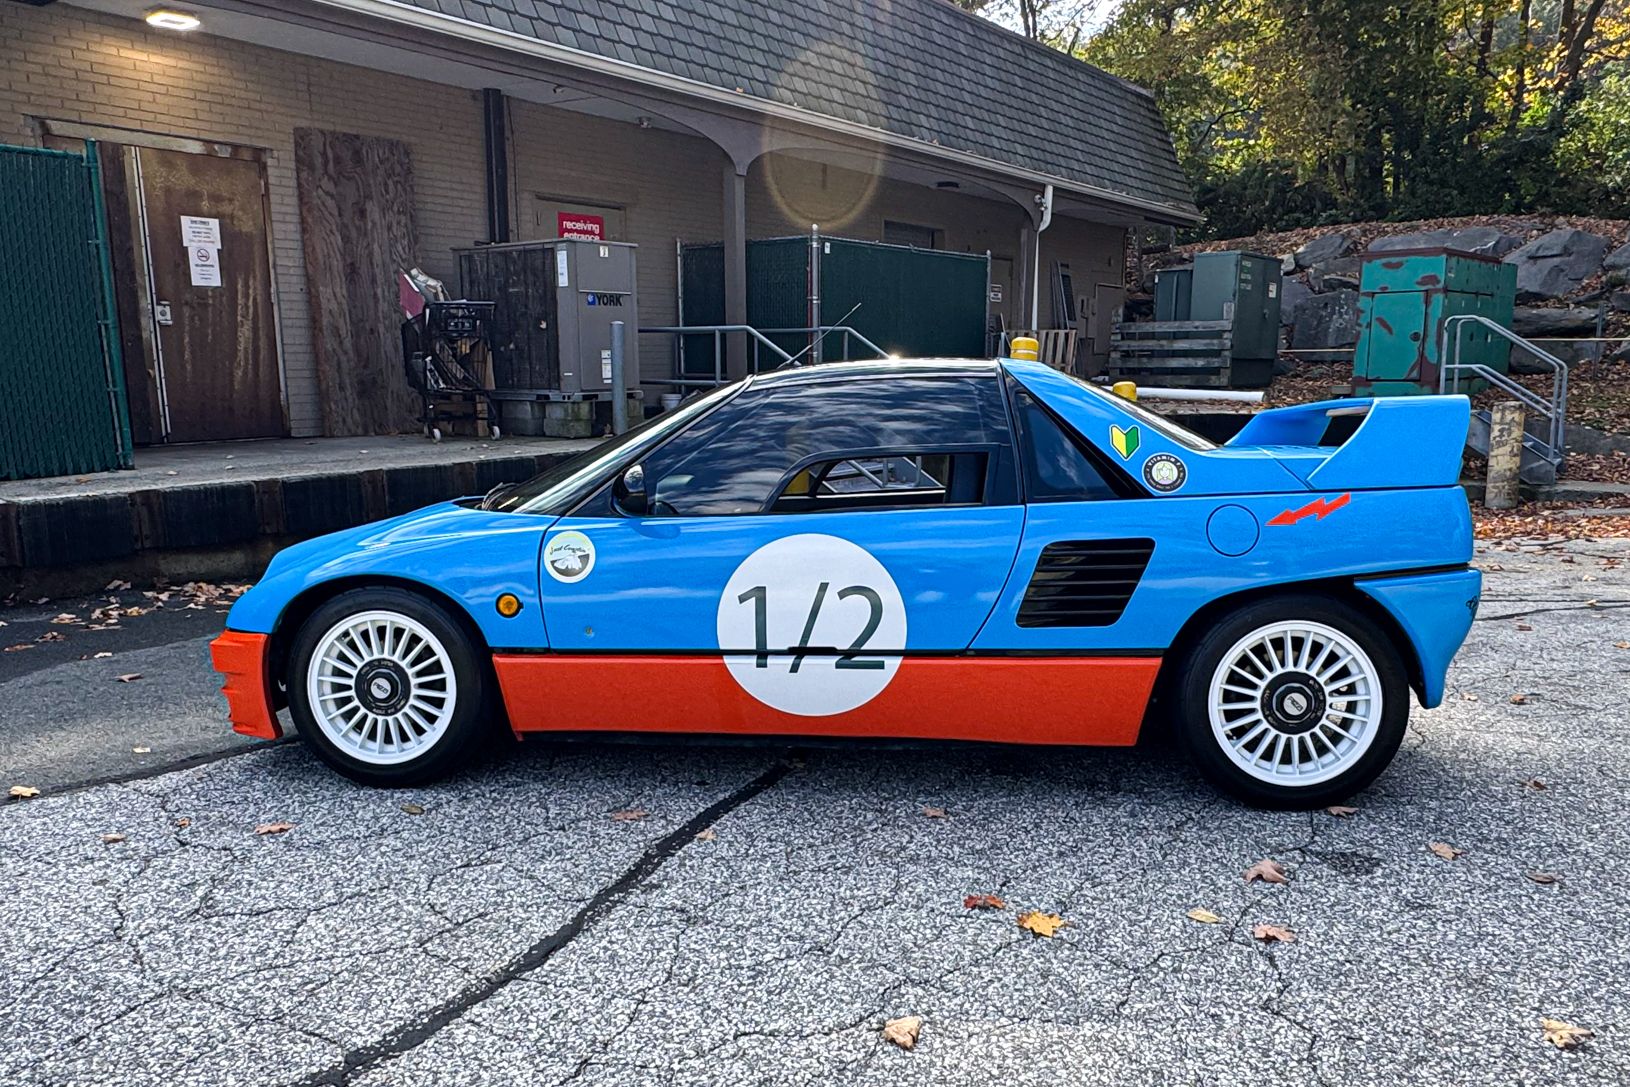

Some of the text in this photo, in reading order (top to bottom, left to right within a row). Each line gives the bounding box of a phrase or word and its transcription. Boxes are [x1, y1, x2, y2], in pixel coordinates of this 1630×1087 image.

[563, 220, 600, 234] receiving
[596, 294, 623, 306] YORK
[737, 582, 885, 673] 1/2
